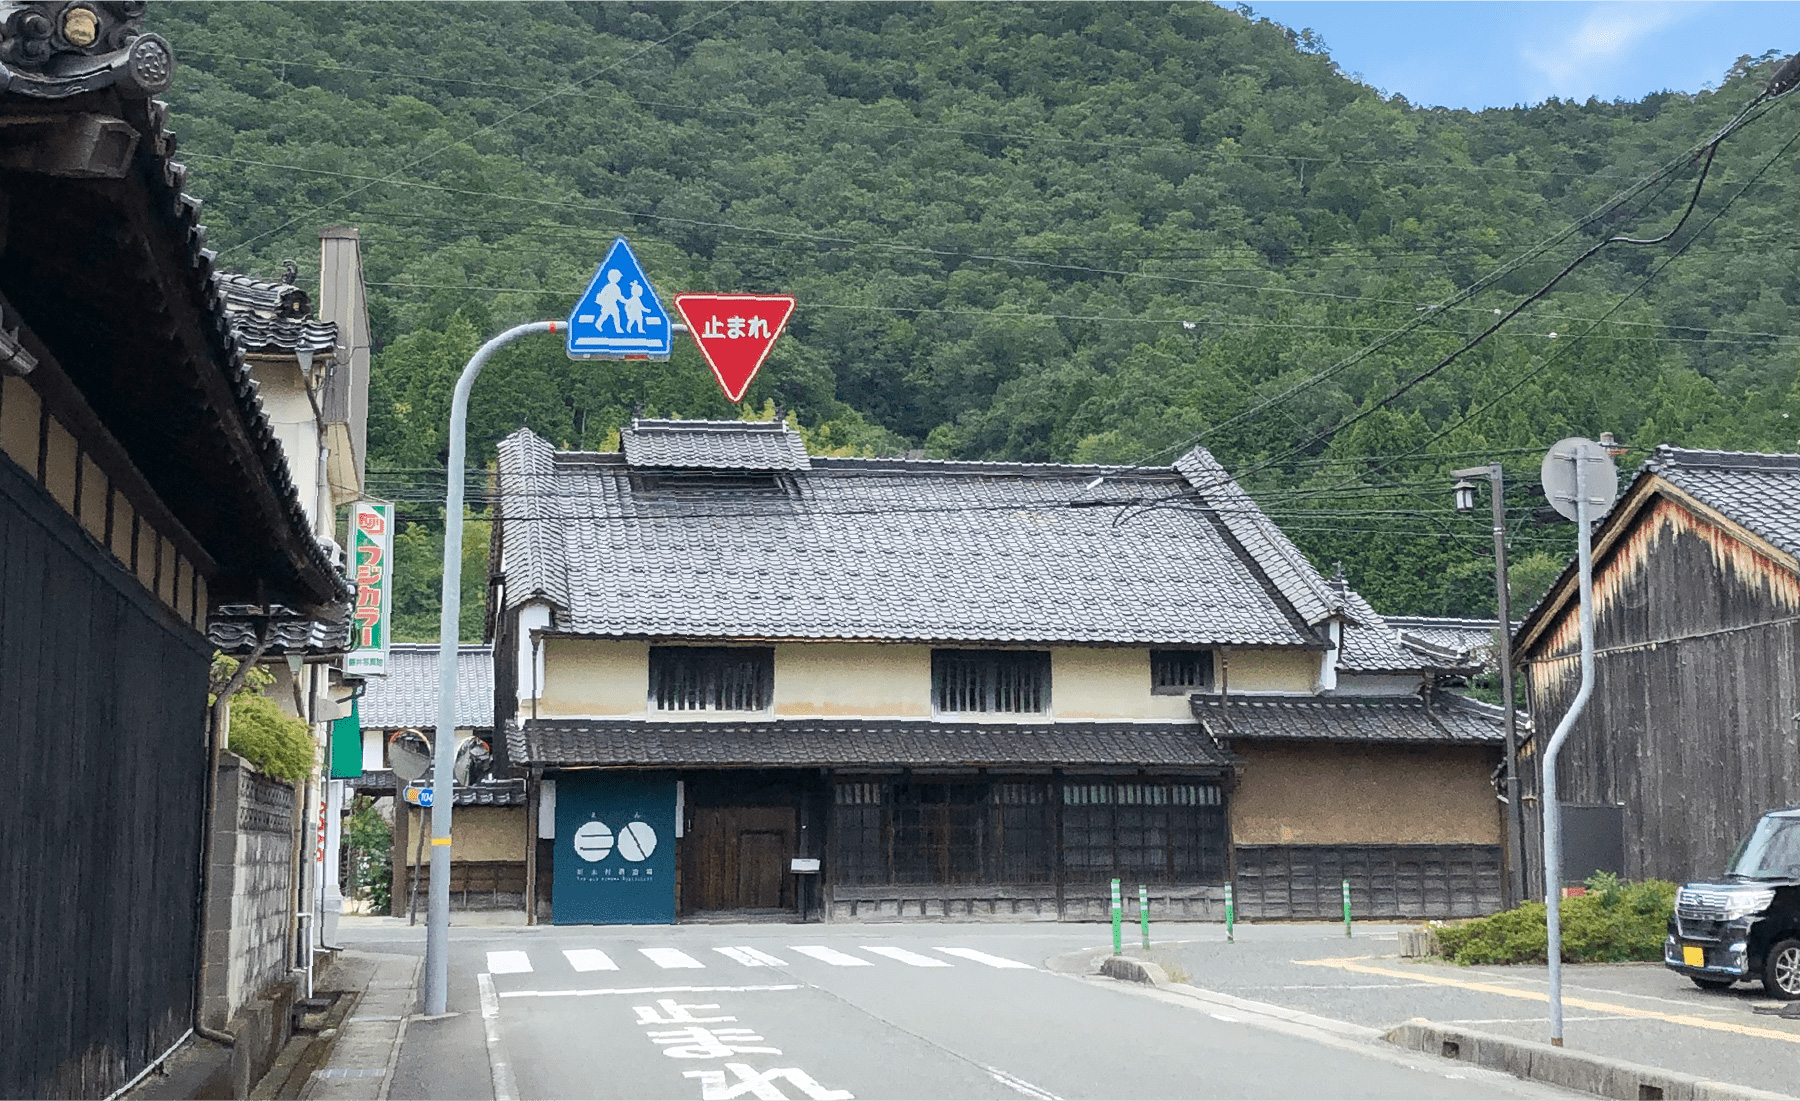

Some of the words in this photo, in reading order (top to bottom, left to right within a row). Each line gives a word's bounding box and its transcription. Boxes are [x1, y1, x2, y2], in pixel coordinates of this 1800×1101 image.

[701, 315, 771, 339] 止まれ
[355, 546, 382, 647] フジカラー
[632, 999, 855, 1101] 止まれ
